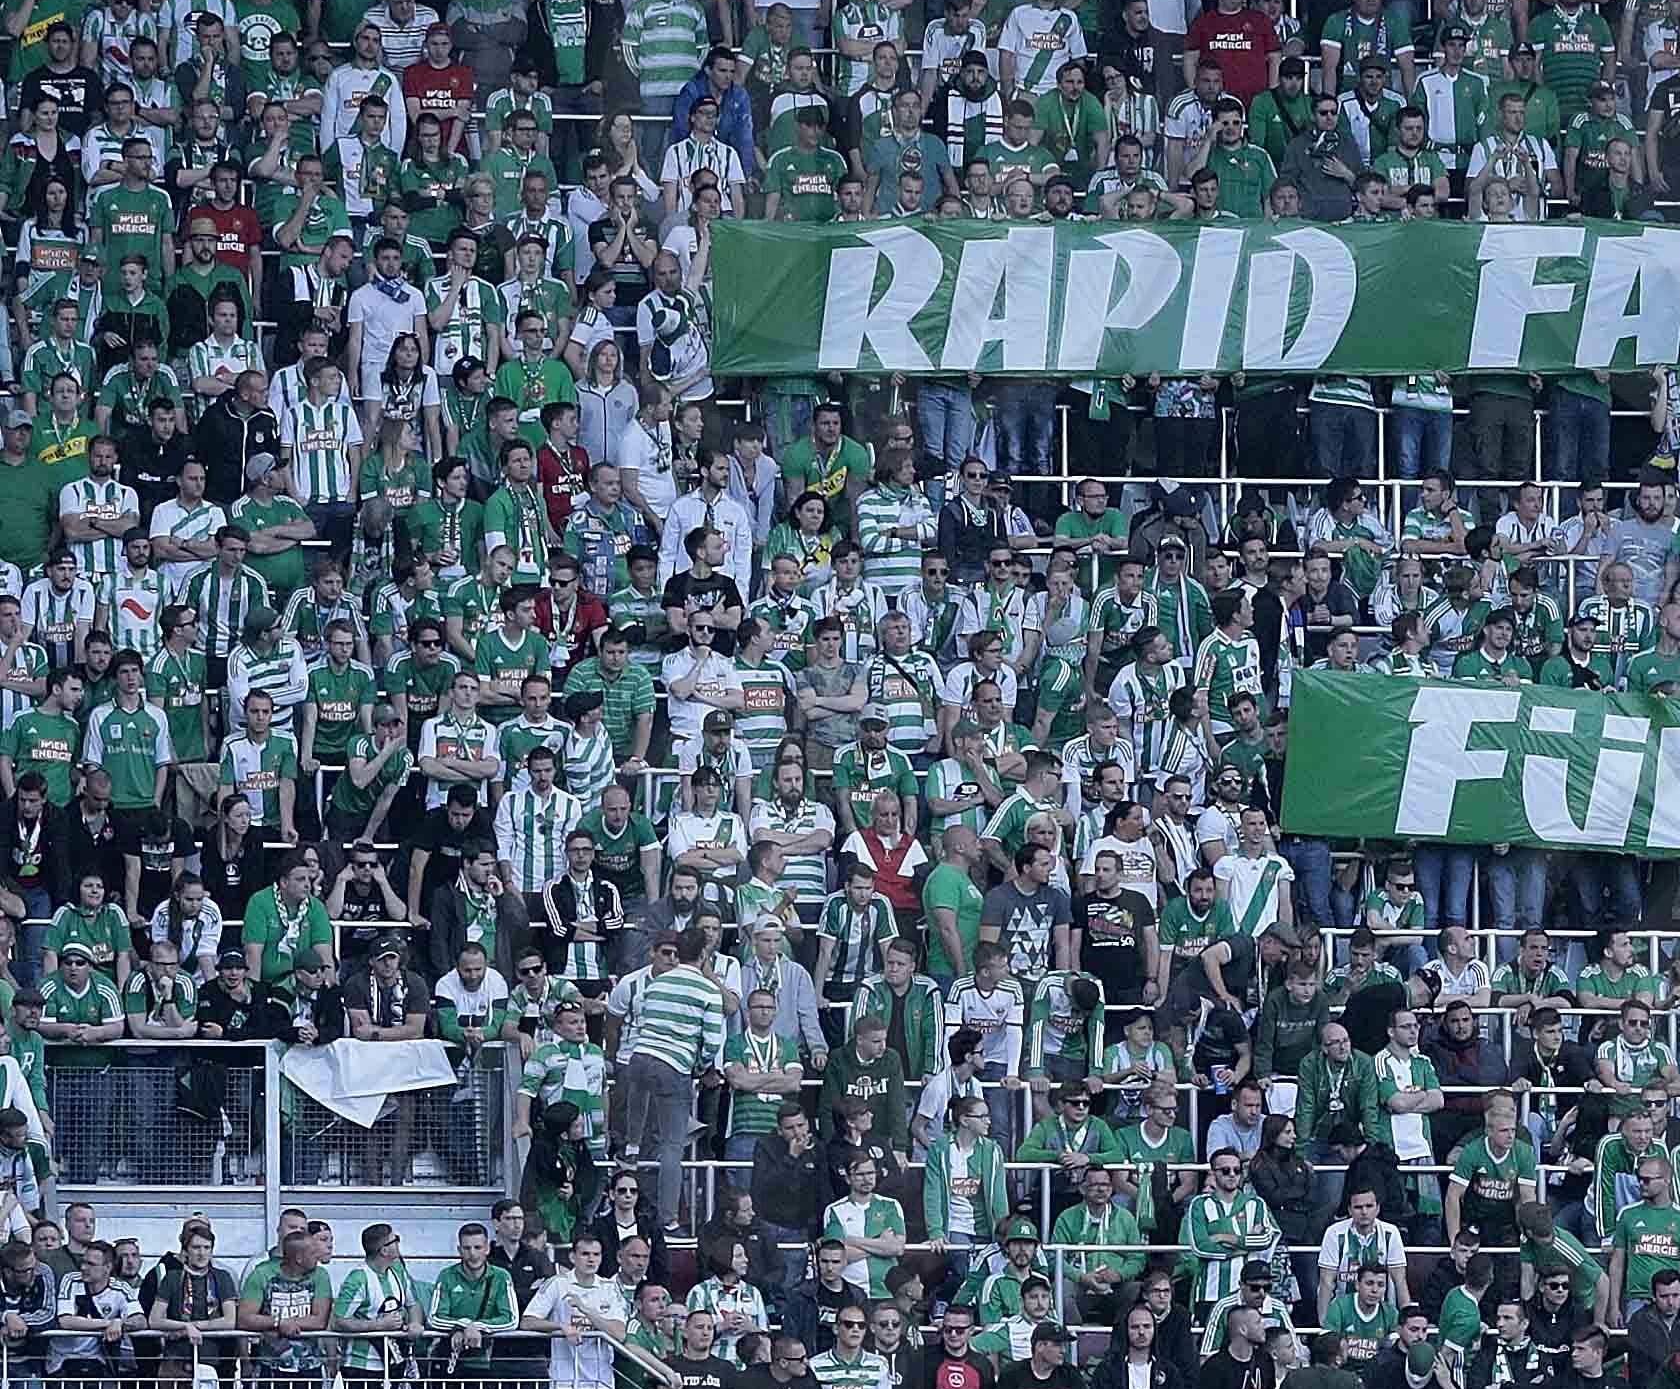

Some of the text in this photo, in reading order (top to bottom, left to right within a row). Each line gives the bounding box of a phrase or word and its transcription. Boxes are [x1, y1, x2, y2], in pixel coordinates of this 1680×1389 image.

[799, 176, 826, 184] WIEN
[120, 215, 148, 223] WIEN
[818, 224, 1357, 370] RAPID
